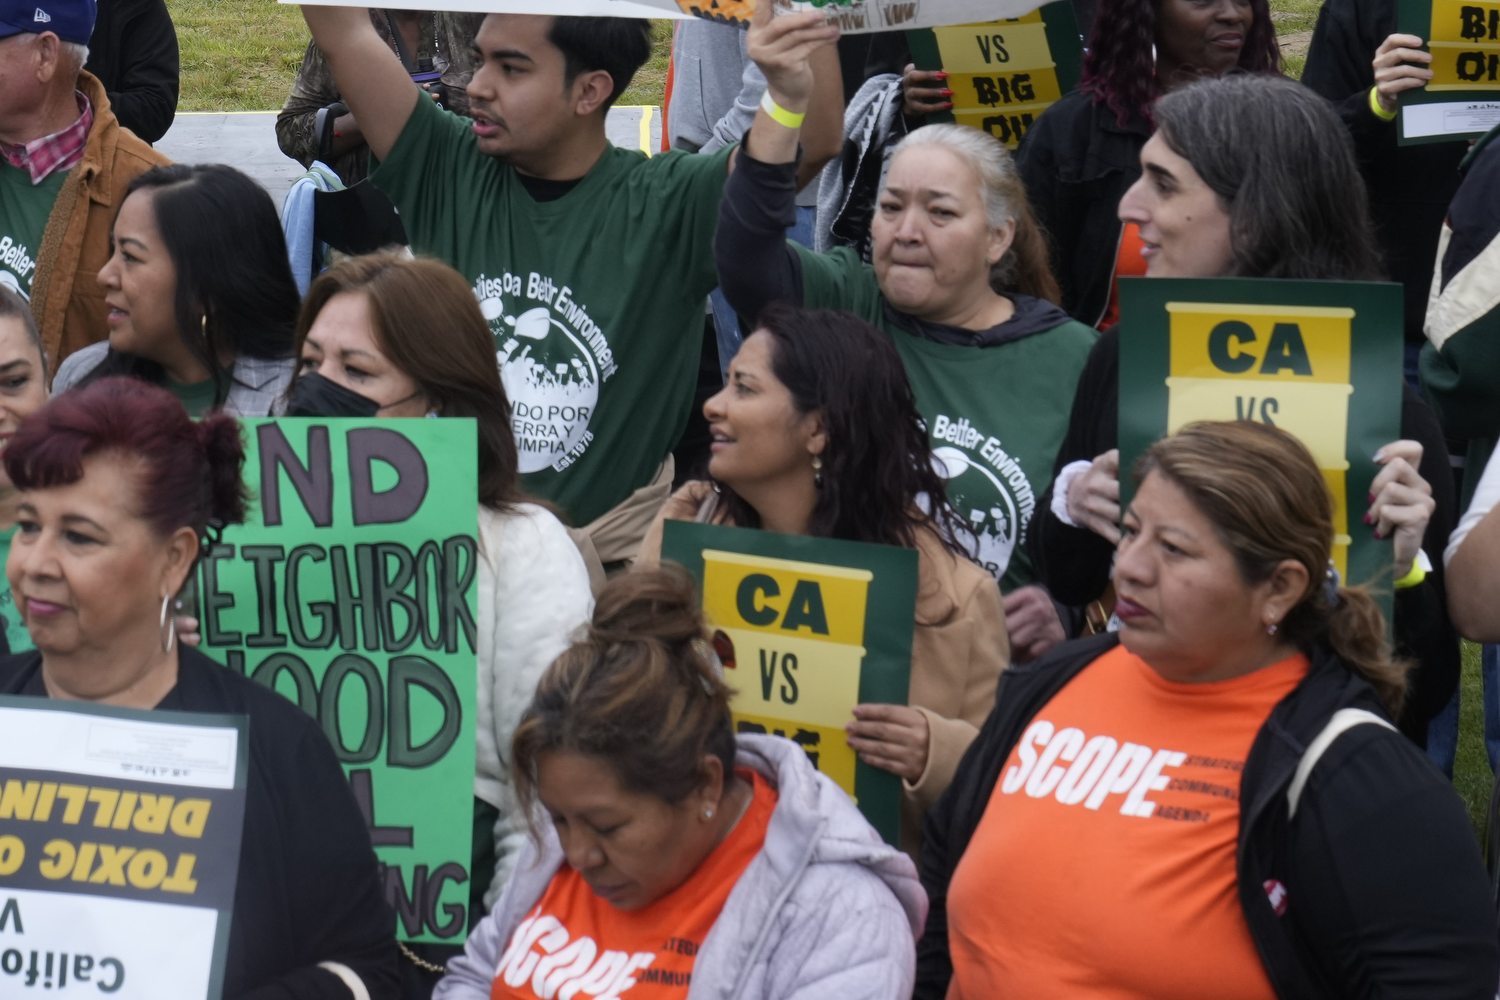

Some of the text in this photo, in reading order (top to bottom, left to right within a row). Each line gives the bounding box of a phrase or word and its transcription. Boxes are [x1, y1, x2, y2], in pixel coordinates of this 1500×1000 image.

[975, 34, 1011, 65] VS
[972, 72, 1037, 108] BIG
[553, 285, 620, 384] Environment
[1207, 319, 1314, 377] CA
[548, 405, 591, 423] POR
[563, 424, 575, 439] Y
[932, 414, 985, 450] Better
[735, 572, 830, 637] CA
[759, 648, 799, 706] VS
[1001, 719, 1188, 819] SCOPE
[37, 837, 199, 895] TOXIC
